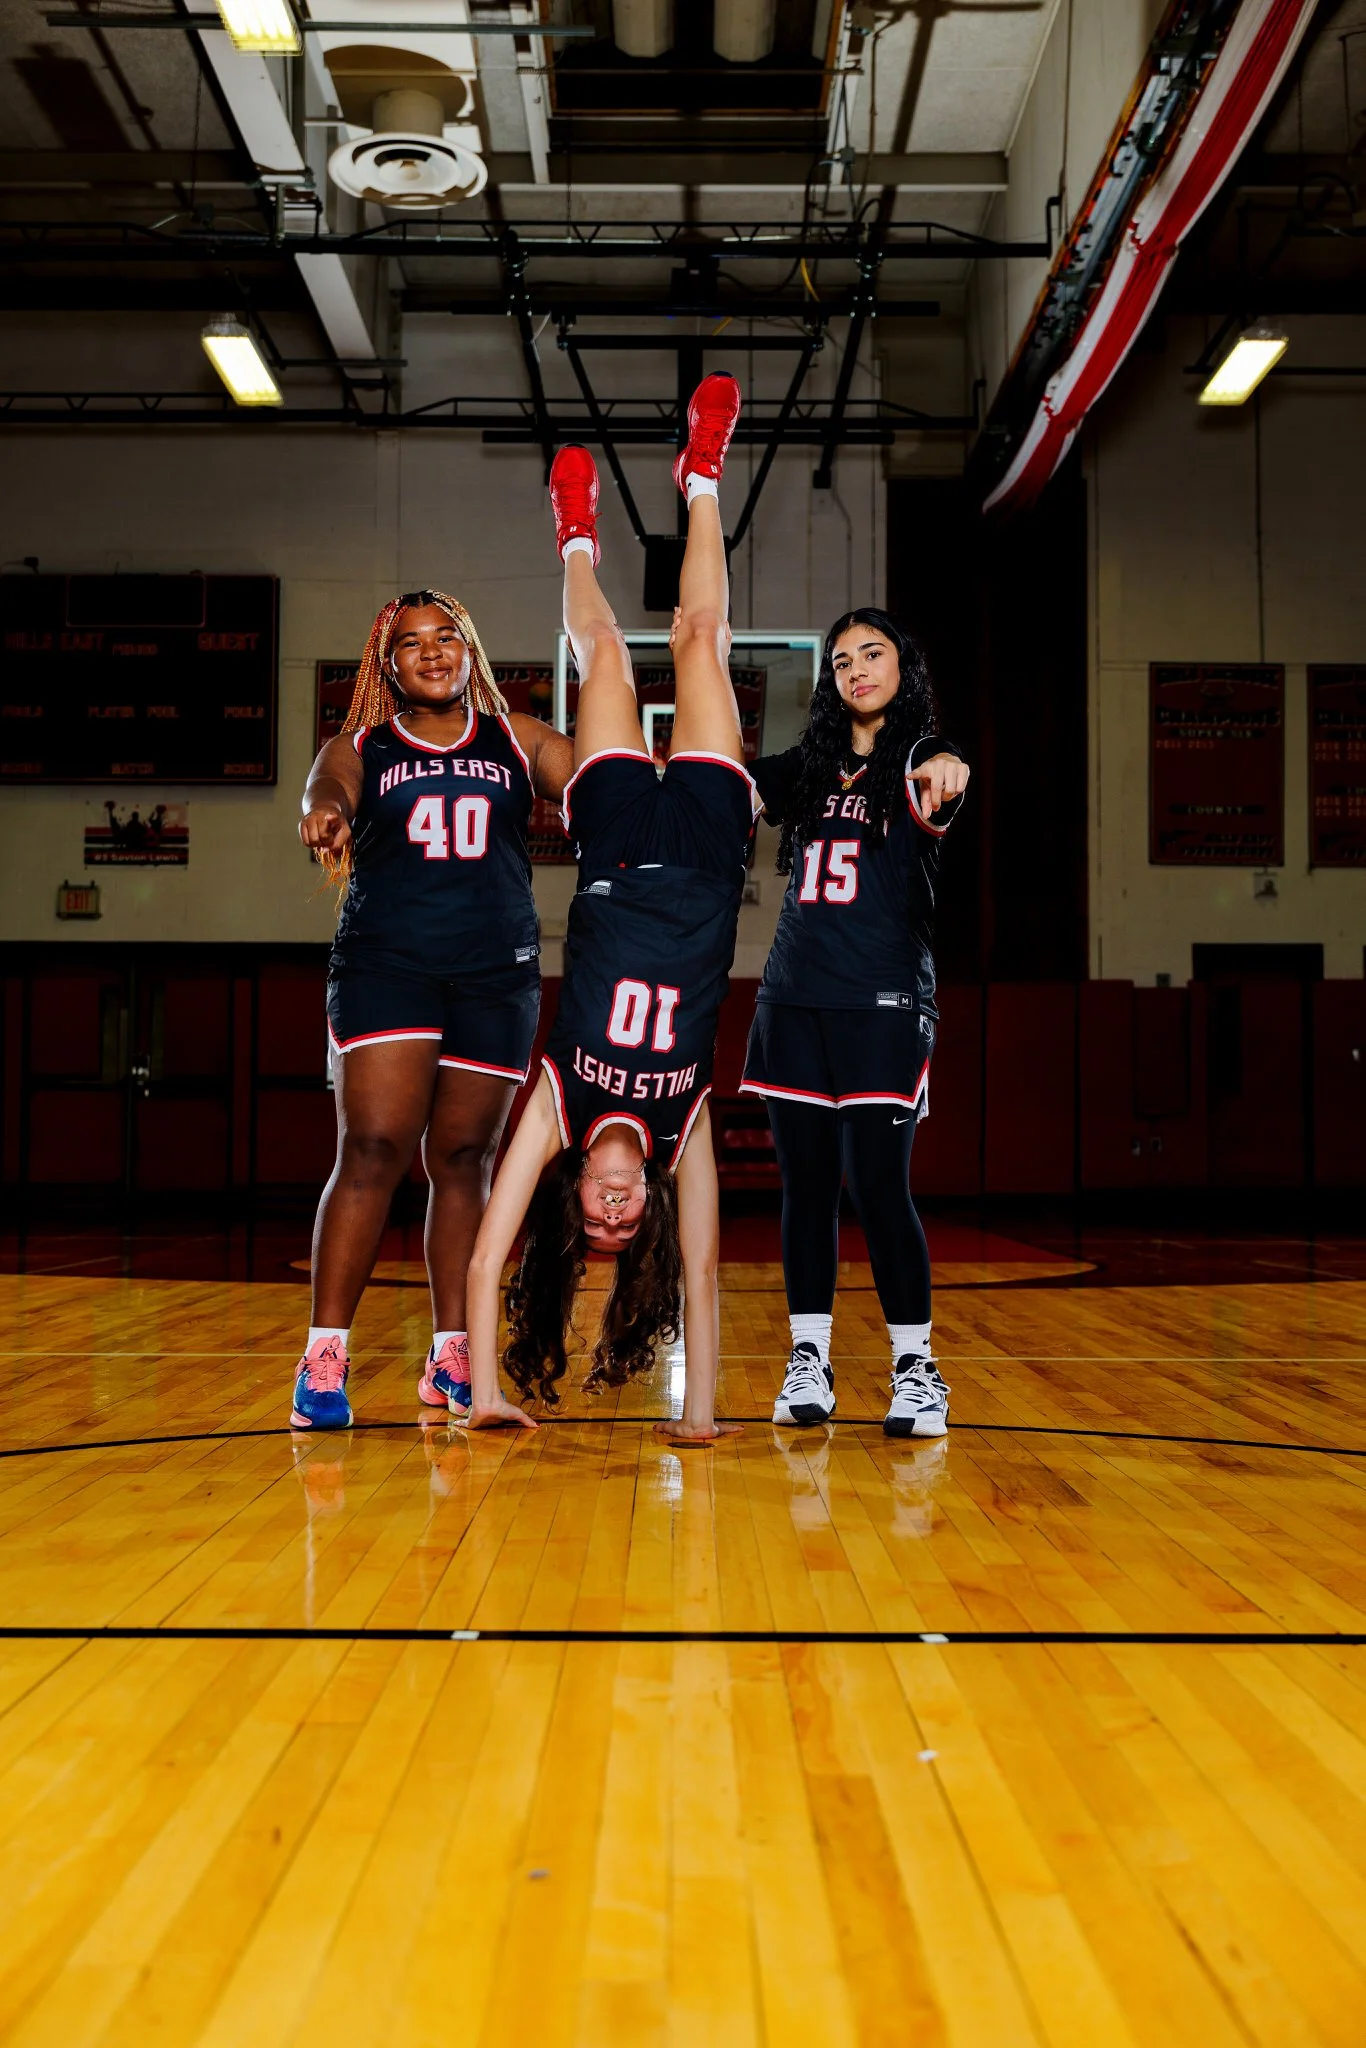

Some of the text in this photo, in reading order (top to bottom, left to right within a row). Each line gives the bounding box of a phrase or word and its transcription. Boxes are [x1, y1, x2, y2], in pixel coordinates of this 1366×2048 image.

[197, 632, 259, 651] GUEST
[379, 757, 513, 799] HILLS EAST
[405, 794, 493, 861] 40
[798, 838, 861, 905] 15
[65, 891, 89, 911] EXIT
[605, 977, 681, 1053] 10
[901, 997, 909, 1005] M
[572, 1045, 698, 1100] HILLS EAST
